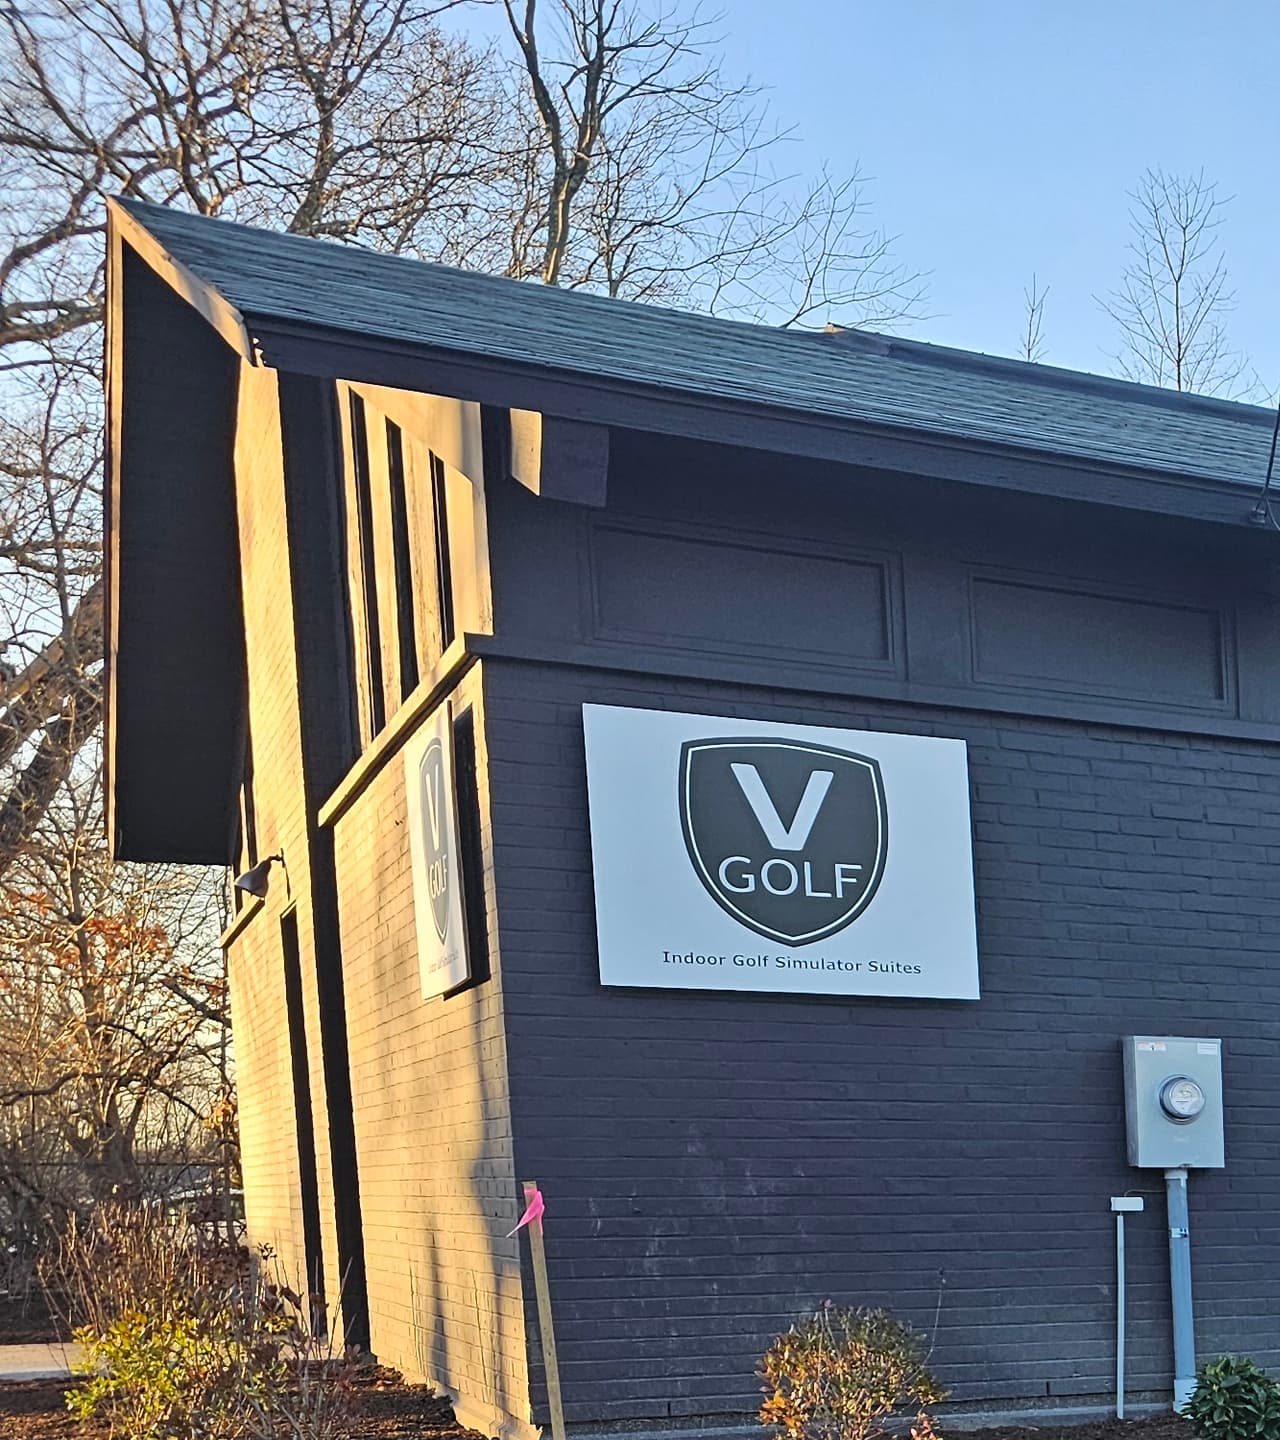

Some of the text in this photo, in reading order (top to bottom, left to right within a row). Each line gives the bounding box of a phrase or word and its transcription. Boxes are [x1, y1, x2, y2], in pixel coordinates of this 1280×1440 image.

[425, 763, 441, 852] V
[730, 763, 834, 851] V
[429, 854, 448, 900] GOLF
[718, 856, 862, 899] GOLF
[663, 951, 922, 974] Indoor Golf Simulator Suites
